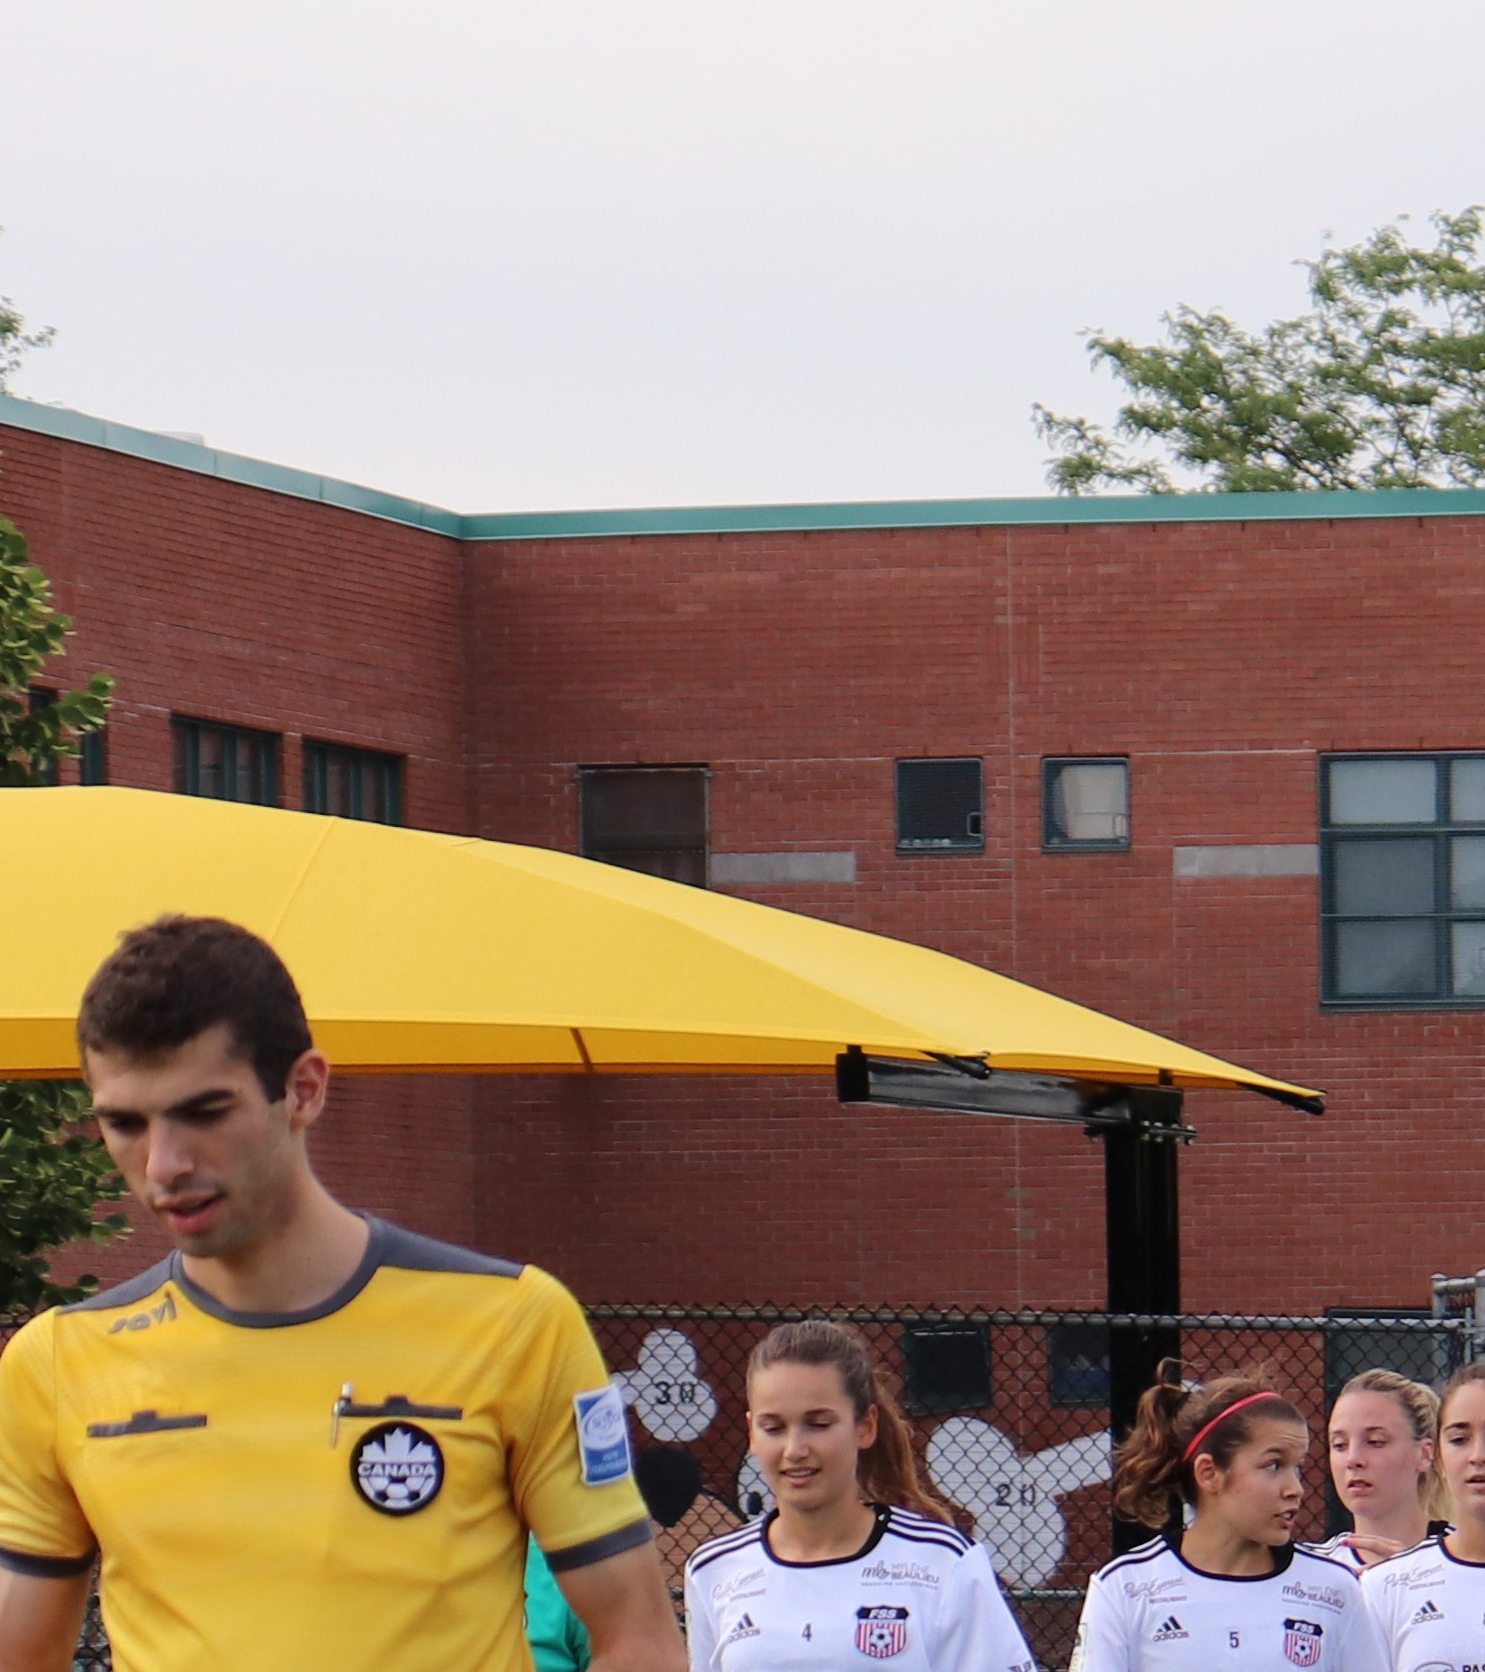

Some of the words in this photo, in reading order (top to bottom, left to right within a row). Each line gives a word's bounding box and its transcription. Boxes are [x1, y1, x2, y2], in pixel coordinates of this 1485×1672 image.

[109, 1291, 177, 1334] savi
[358, 1462, 435, 1479] CANADA
[869, 1609, 897, 1619] FSS
[1411, 1612, 1445, 1625] adidas
[727, 1628, 761, 1643] adidas
[801, 1623, 812, 1642] 4
[1152, 1629, 1189, 1642] adidas
[1294, 1622, 1314, 1634] FSS
[1228, 1631, 1240, 1649] 5
